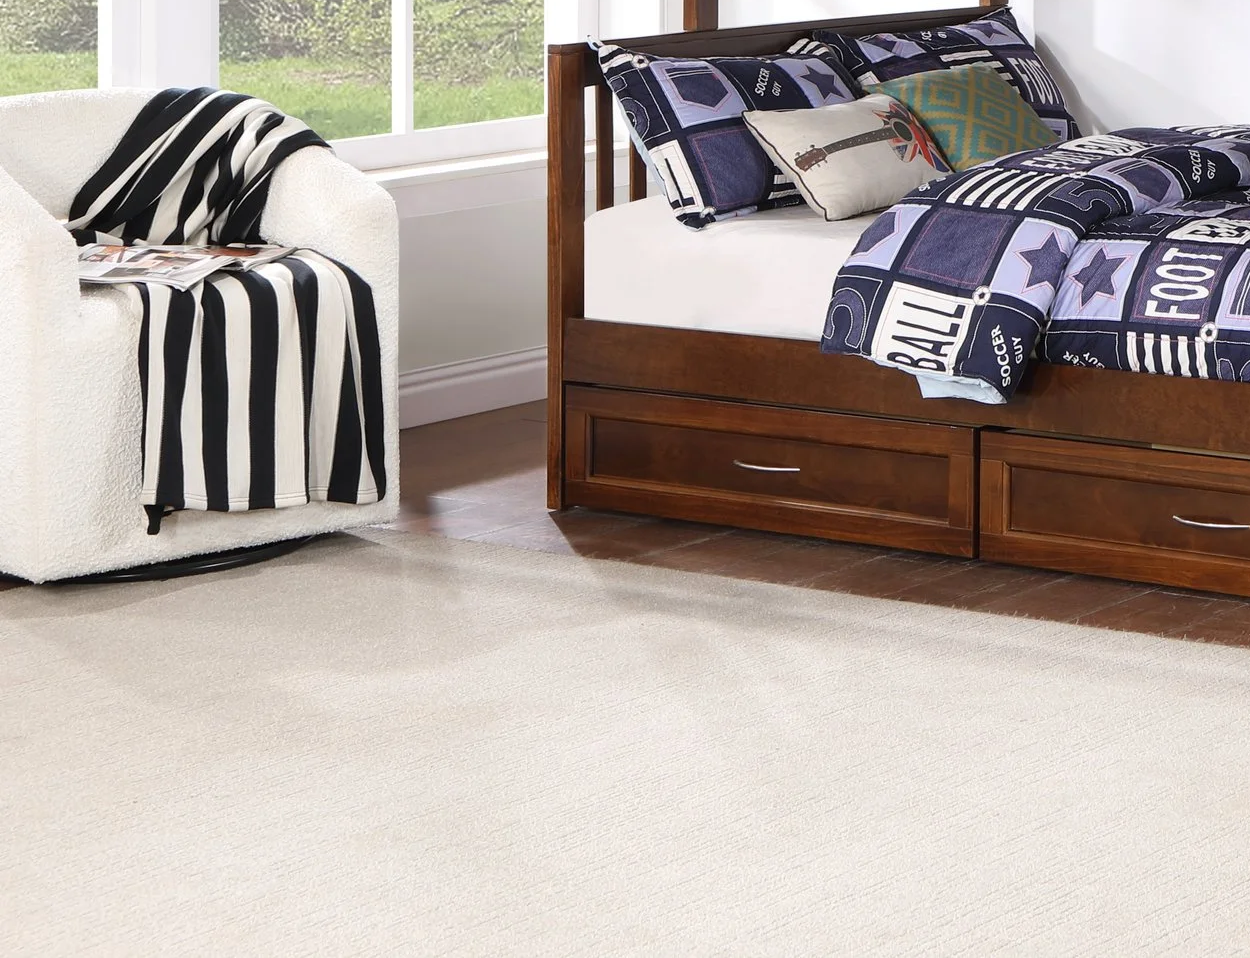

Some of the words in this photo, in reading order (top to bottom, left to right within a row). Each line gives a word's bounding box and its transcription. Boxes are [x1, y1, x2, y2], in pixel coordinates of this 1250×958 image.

[754, 67, 771, 97] SOCCER
[771, 81, 783, 97] GUY
[1207, 159, 1217, 180] GUY
[1144, 247, 1224, 320] FOOT
[886, 301, 967, 373] BALL
[1011, 336, 1024, 364] GUY
[990, 324, 1012, 387] SOCCER
